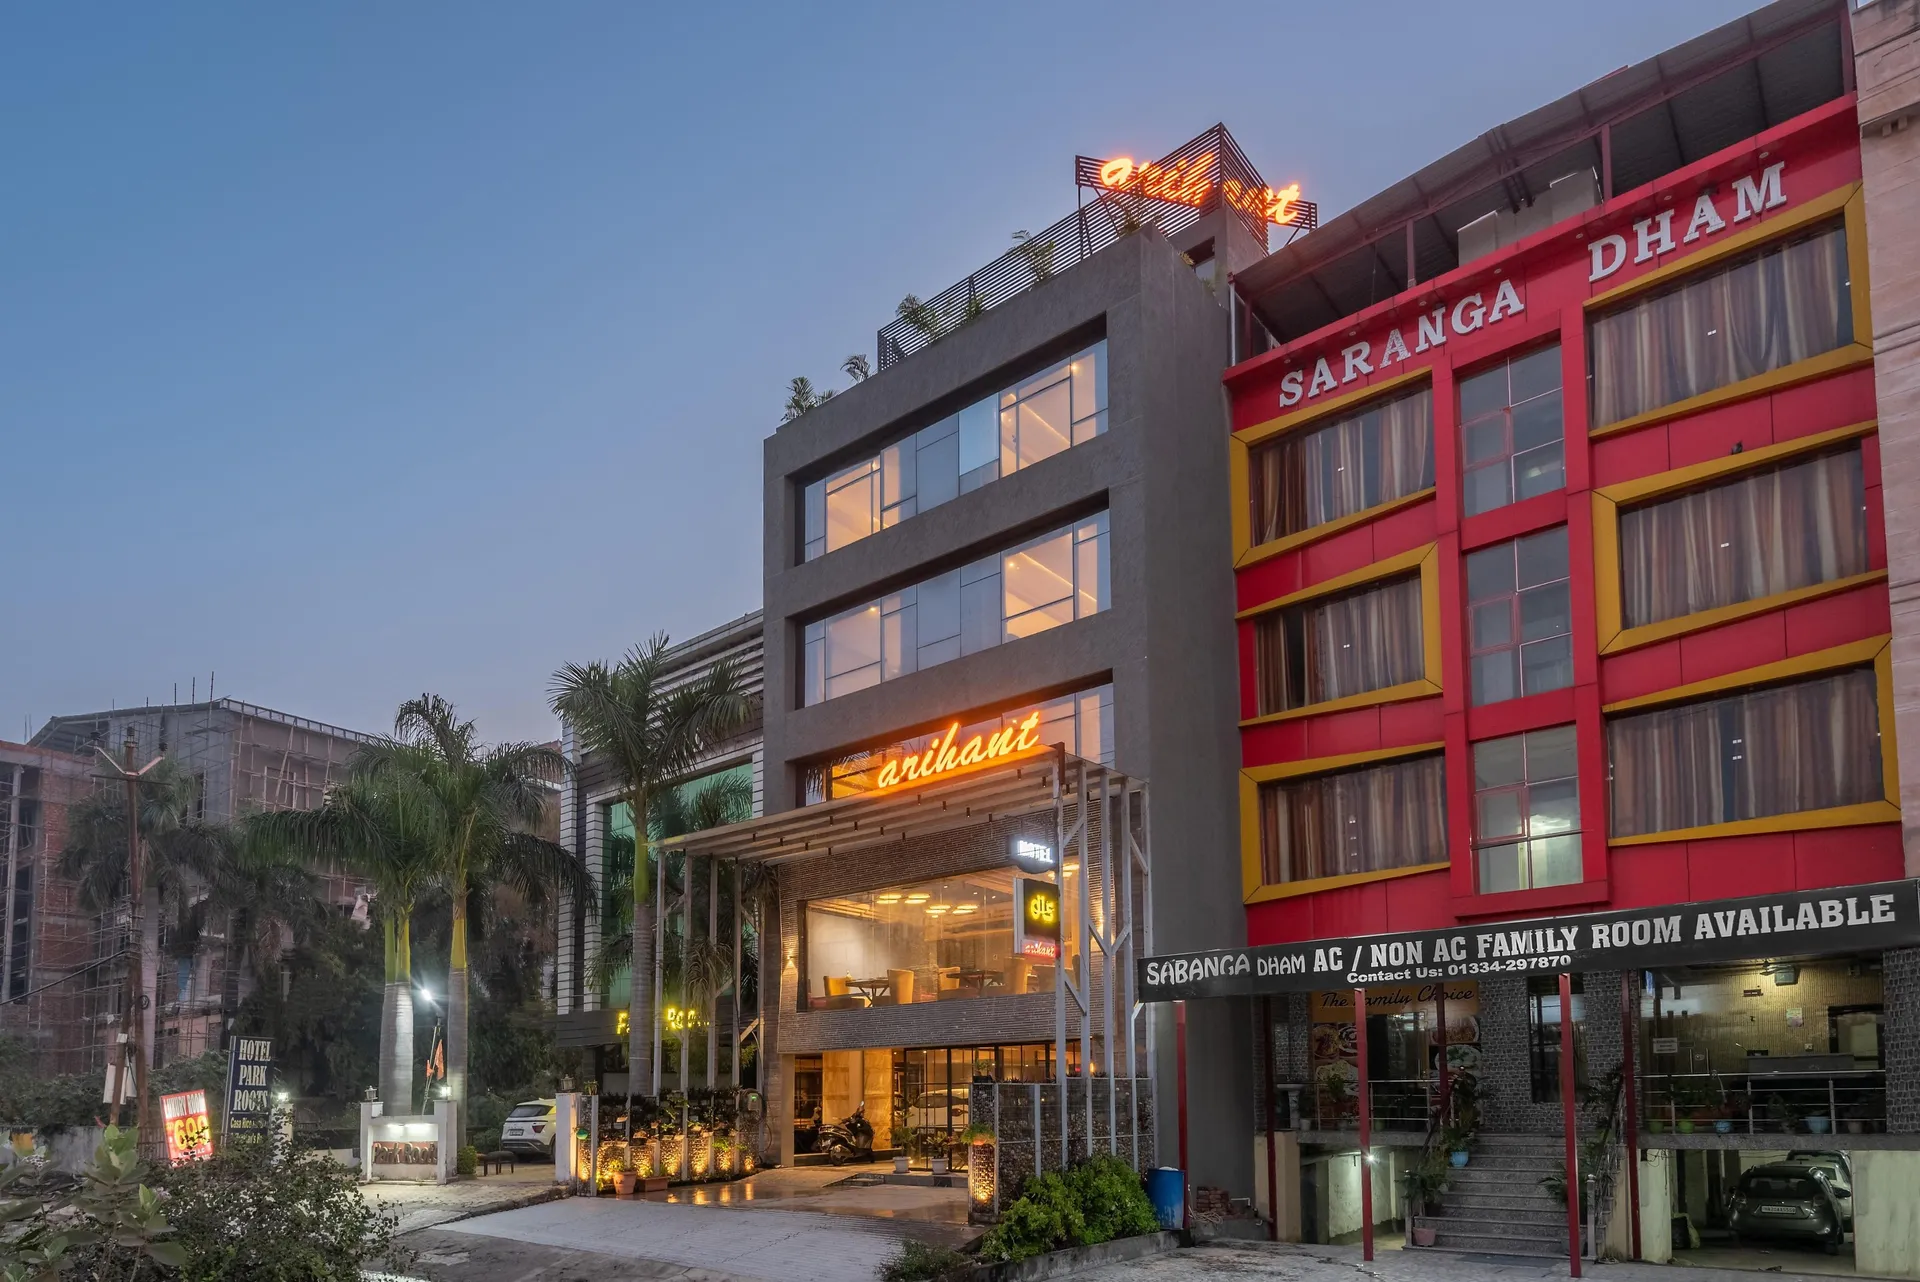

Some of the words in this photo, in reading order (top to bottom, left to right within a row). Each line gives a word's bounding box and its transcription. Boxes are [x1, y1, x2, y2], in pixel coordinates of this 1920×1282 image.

[1279, 279, 1525, 408] SARANGA
[1588, 161, 1787, 282] DHAM
[877, 711, 1039, 788] arihant
[1257, 953, 1306, 976] DHAM
[1313, 946, 1343, 972] AC
[1370, 940, 1423, 968] NON
[1433, 936, 1467, 963] AC
[1476, 926, 1579, 958] FAMILY
[1591, 915, 1682, 949] ROOM
[1694, 894, 1896, 940] AVAILABLE
[1347, 965, 1411, 984] Contact
[1416, 967, 1443, 980] Us:
[1448, 954, 1572, 977] 01334-297870
[1321, 992, 1348, 1009] The
[238, 1039, 272, 1061] HOTEL
[238, 1064, 267, 1086] PARK
